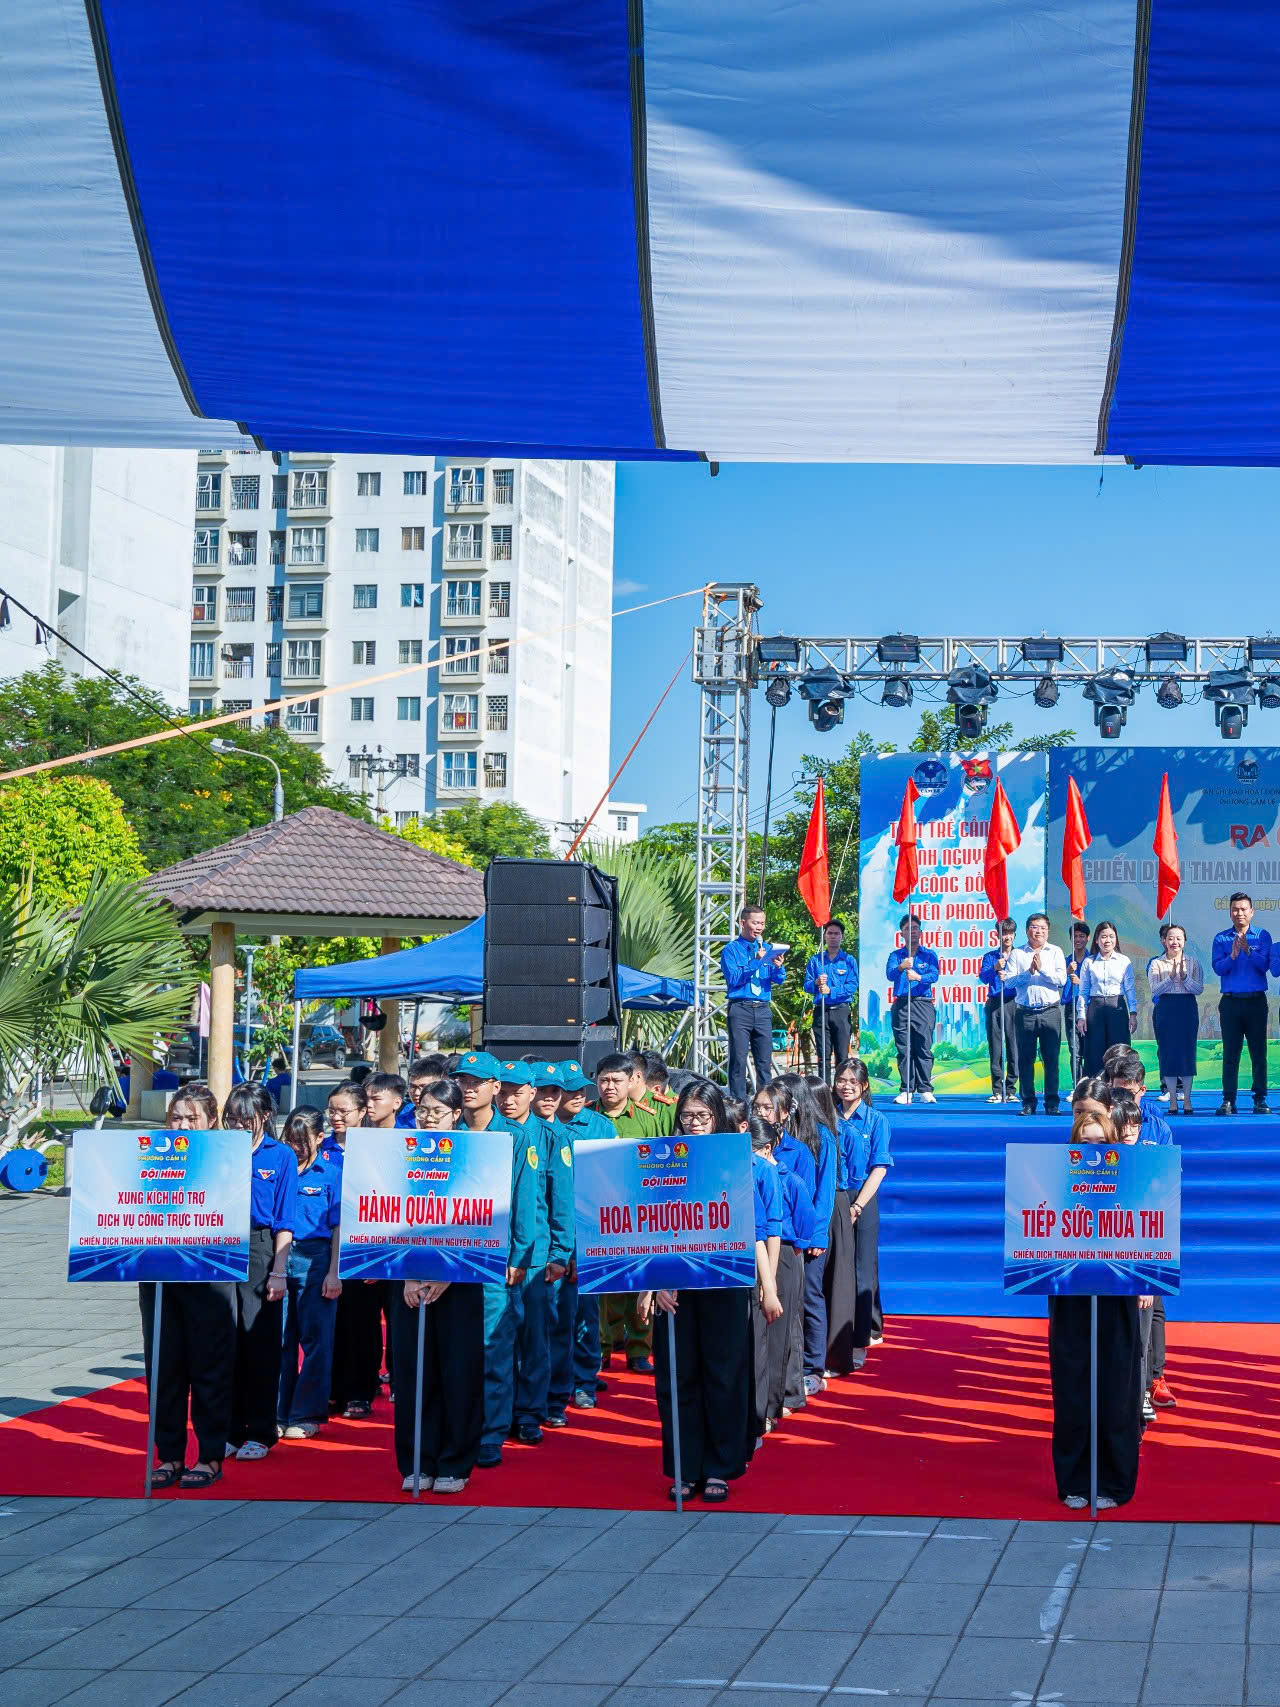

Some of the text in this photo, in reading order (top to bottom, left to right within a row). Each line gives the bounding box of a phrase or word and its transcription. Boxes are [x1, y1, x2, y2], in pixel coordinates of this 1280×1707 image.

[929, 817, 955, 838] TRẺ
[1230, 824, 1270, 848] RA
[1083, 853, 1137, 881] CHIẾN
[1190, 860, 1249, 881] THANH
[921, 875, 958, 896] CỘNG
[1254, 899, 1277, 910] ngày
[941, 984, 972, 1003] VĂN
[140, 1167, 185, 1180] ĐỘI HÌNH
[407, 1169, 449, 1181] ĐỘI HÌNH
[642, 1175, 687, 1189] ĐỘI HÌNH
[118, 1186, 205, 1207] XUNG KÍCH HỖ TRỢ
[1072, 1182, 1116, 1194] ĐỘI HÌNH
[359, 1190, 493, 1227] HÀNH QUÂN XANH
[600, 1192, 730, 1237] HOA PHƯỢNG ĐỎ
[98, 1210, 223, 1229] DỊCH VỤ CÔNG TRỰC TUYẾN
[1022, 1201, 1164, 1238] TIẾP SỨC MÙA THI
[121, 1237, 144, 1245] THANH
[146, 1235, 163, 1245] NIÊN
[224, 1237, 240, 1245] 2026
[389, 1236, 409, 1244] THANH
[411, 1235, 427, 1245] NIÊN
[627, 1246, 650, 1255] THANH
[652, 1244, 669, 1254] NIÊN
[730, 1242, 746, 1250] 2026
[1054, 1251, 1076, 1259] THANH
[1078, 1249, 1095, 1259] NIÊN
[1155, 1252, 1171, 1260] 2026
